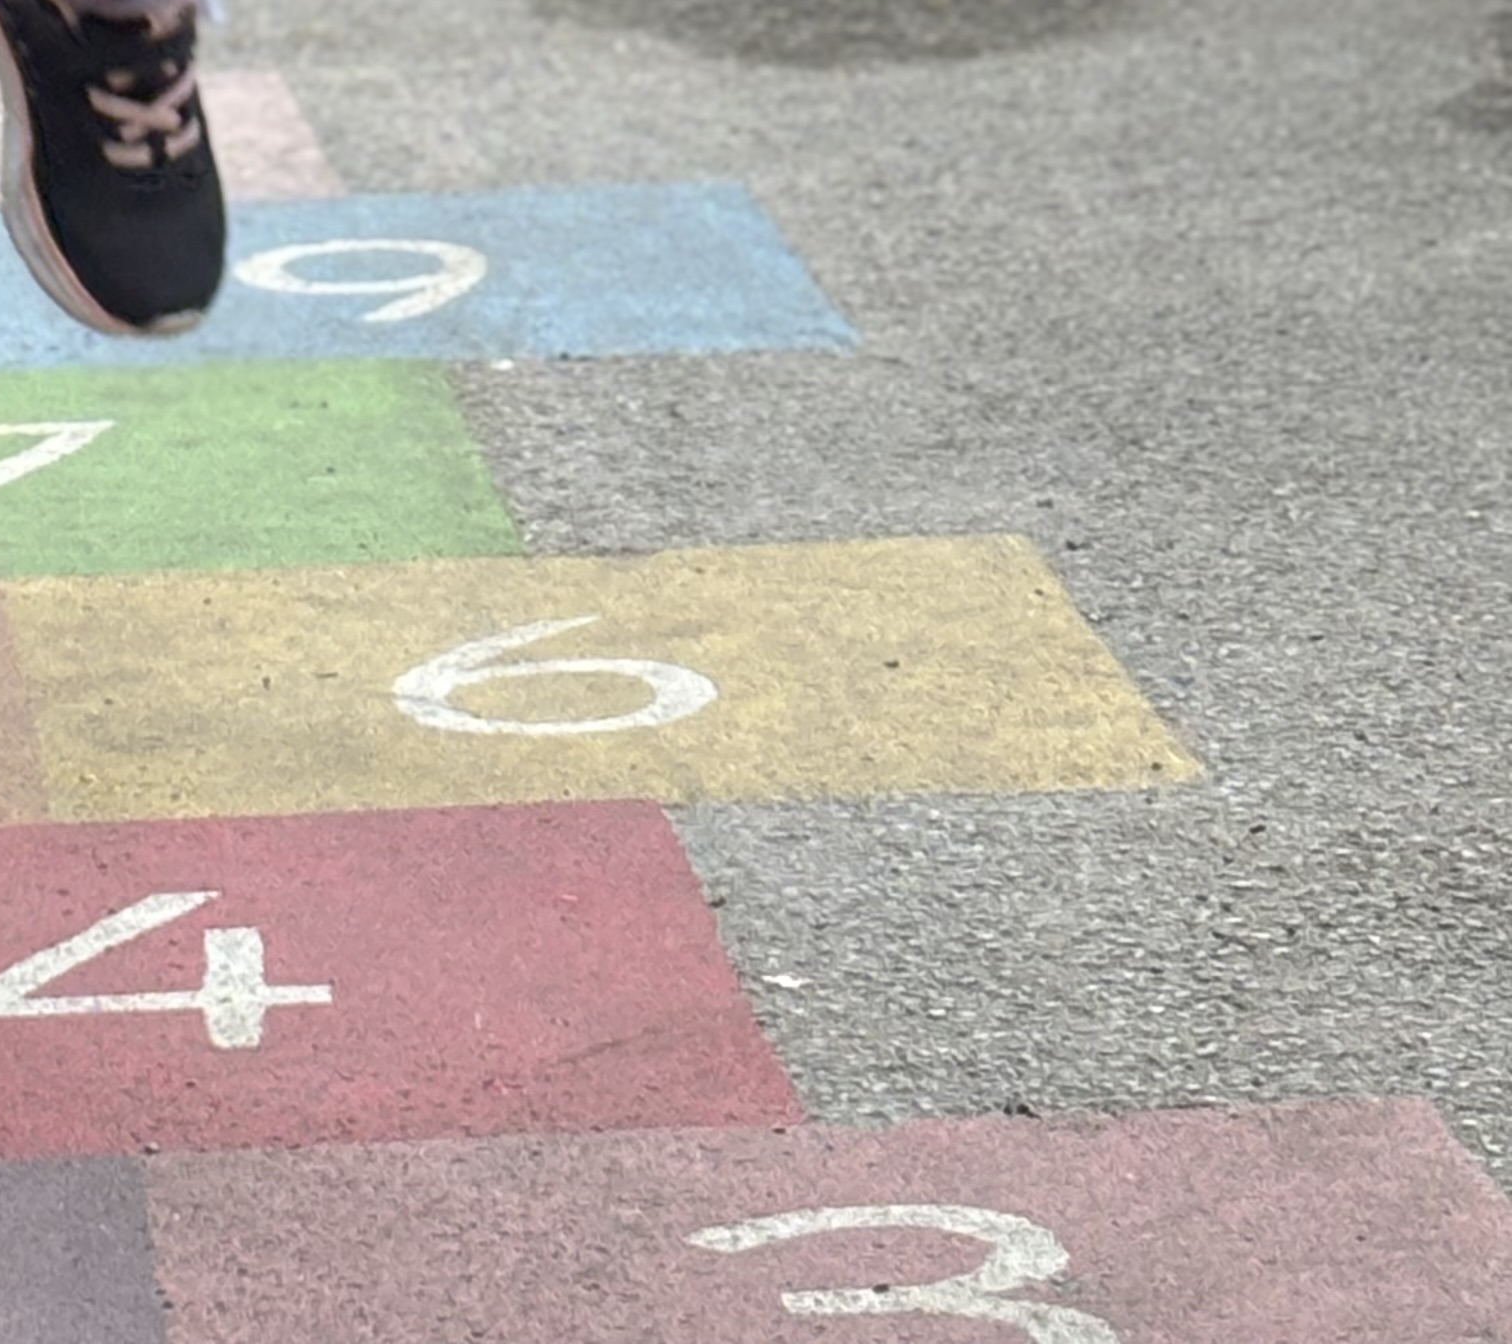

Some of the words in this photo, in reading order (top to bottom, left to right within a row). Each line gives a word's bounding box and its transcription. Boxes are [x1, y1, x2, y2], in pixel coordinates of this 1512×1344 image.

[233, 238, 488, 323] 9
[393, 615, 719, 734] 6
[684, 1204, 1120, 1344] 3
